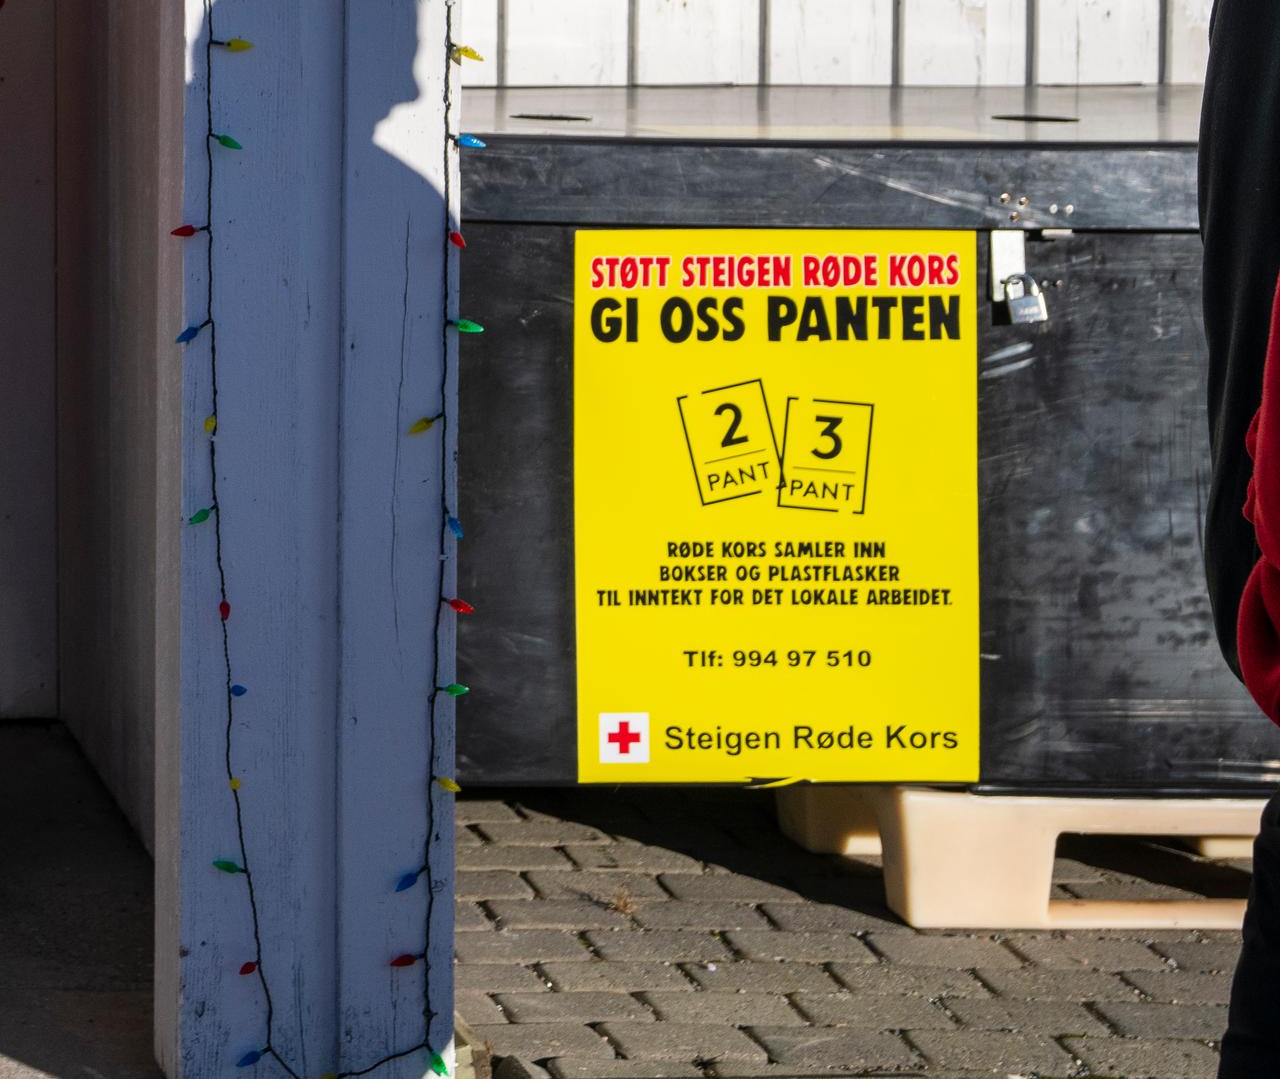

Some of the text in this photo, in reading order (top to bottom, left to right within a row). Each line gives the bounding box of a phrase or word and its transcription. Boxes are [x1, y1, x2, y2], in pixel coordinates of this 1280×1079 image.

[591, 255, 959, 289] STØTT STEIGEN RØDE KORS
[590, 295, 961, 343] GI OSS PANTEN
[713, 402, 749, 448] 2
[810, 415, 844, 460] 3
[707, 460, 771, 492] PANT
[787, 477, 856, 503] PANT
[667, 541, 886, 559] RØDE KORS SAMLER INN
[659, 565, 901, 582] BOKSER OG PLASTFLASKER
[596, 588, 953, 607] TIL INNTEKT FOR DET LOKALE ARBEIDET.
[683, 650, 872, 667] Tlf: 994 97 510
[665, 725, 958, 756] Steigen Røde Kors
